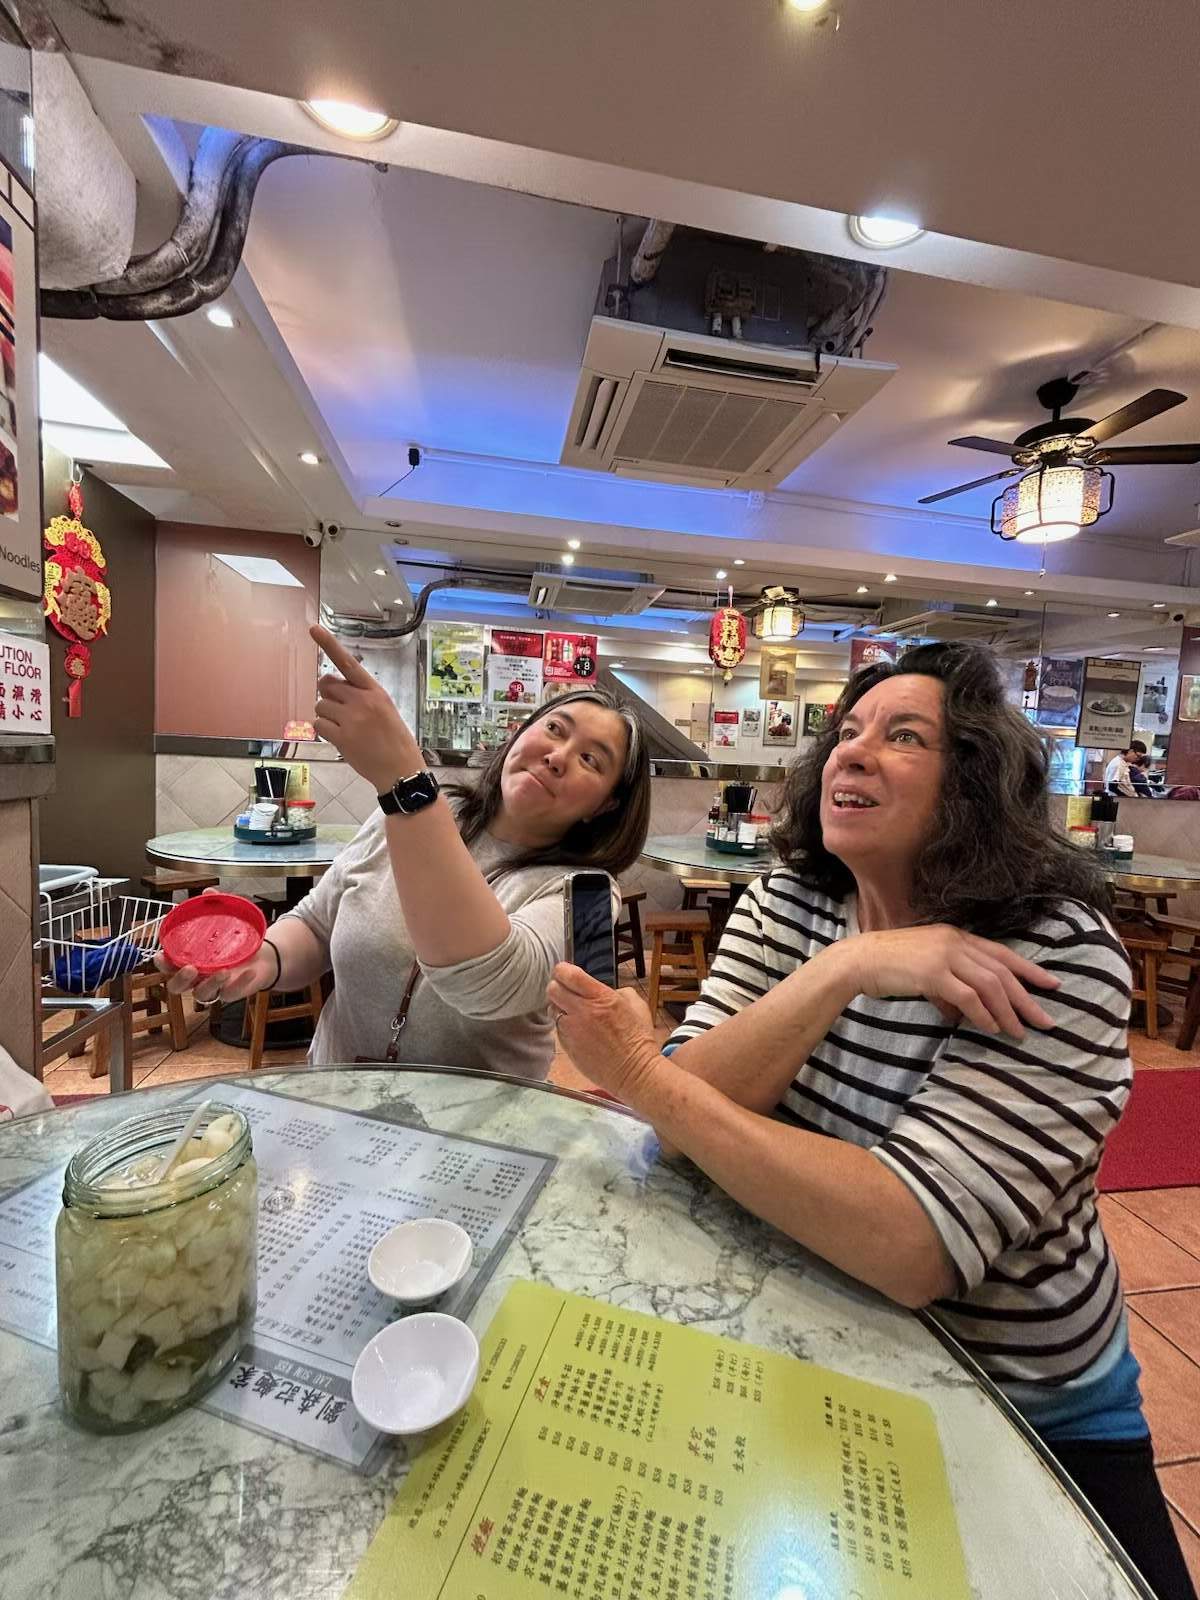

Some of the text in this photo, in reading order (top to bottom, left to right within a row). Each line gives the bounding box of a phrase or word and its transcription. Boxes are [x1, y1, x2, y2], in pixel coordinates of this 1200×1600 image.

[5, 661, 41, 680] FLOOR
[314, 1375, 333, 1388] LAU
[230, 1366, 347, 1424] 劉森記麵家
[538, 1426, 548, 1440] $50
[552, 1432, 562, 1445] $50
[566, 1437, 576, 1451] $50
[580, 1441, 590, 1456] $50
[594, 1447, 604, 1461] $50
[608, 1452, 618, 1466] $50
[623, 1457, 632, 1472] $50
[638, 1462, 647, 1477] $50
[883, 1553, 894, 1571] $16
[901, 1559, 912, 1579] $16
